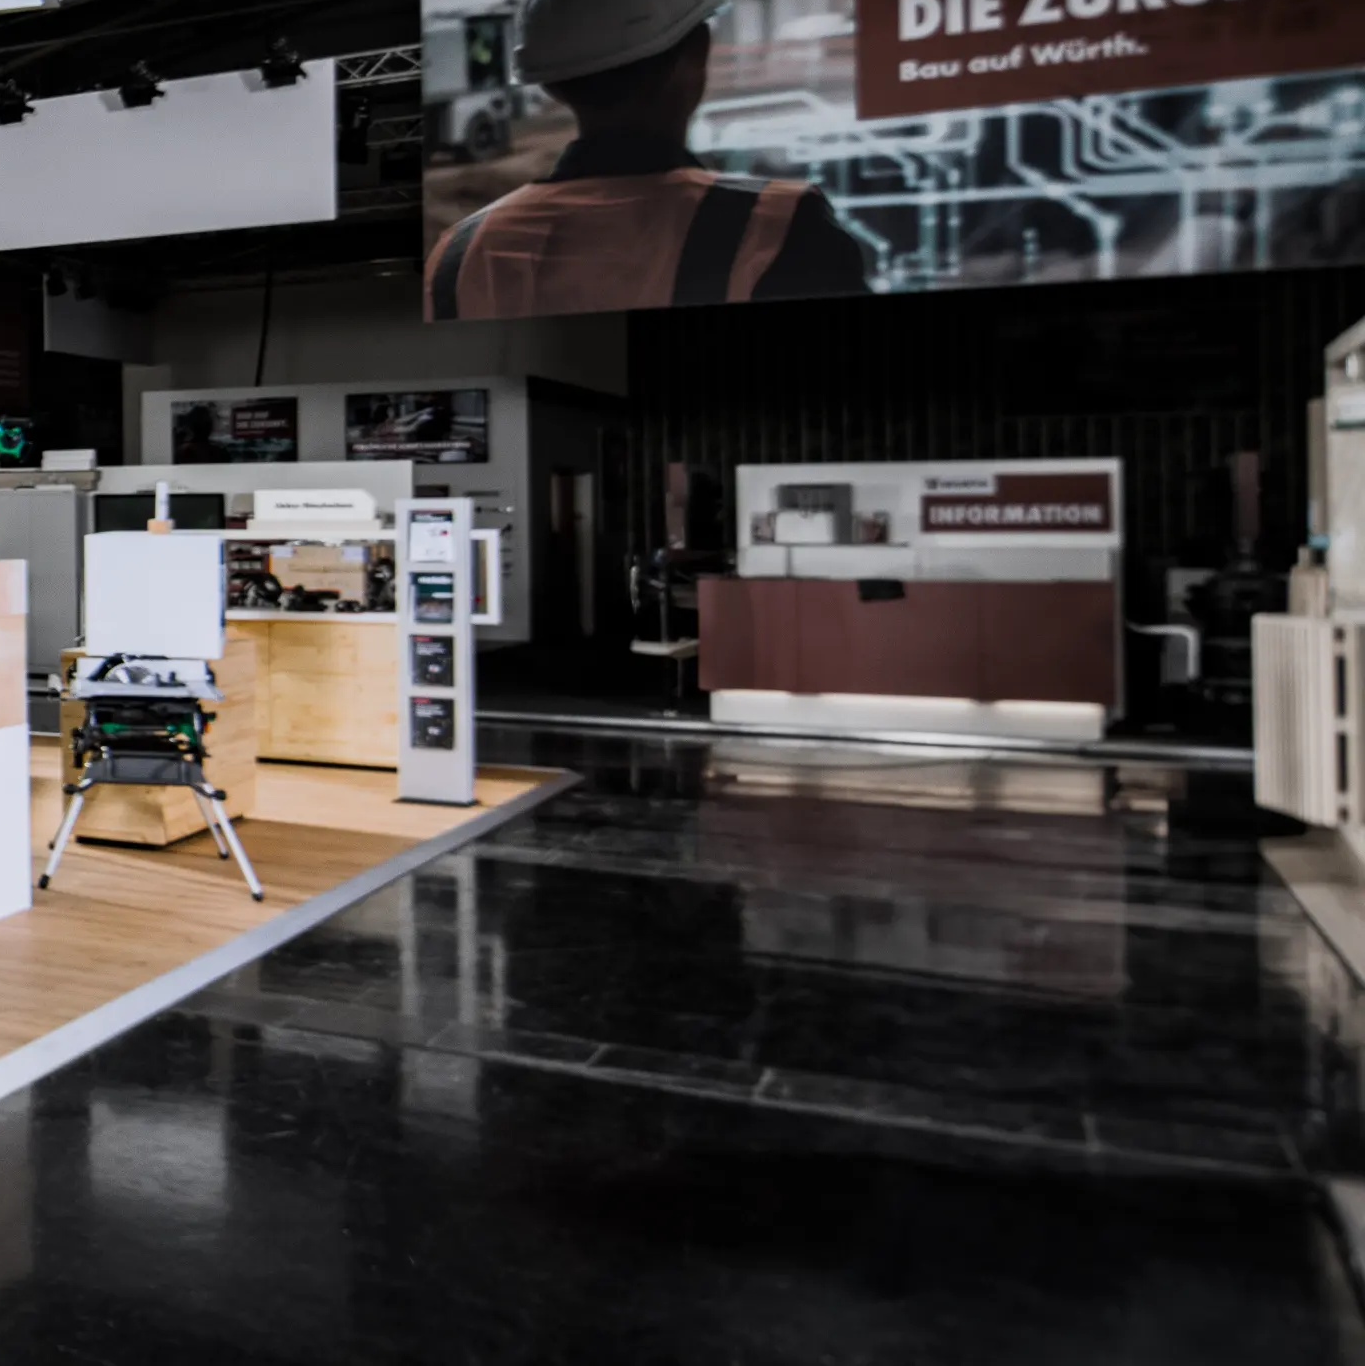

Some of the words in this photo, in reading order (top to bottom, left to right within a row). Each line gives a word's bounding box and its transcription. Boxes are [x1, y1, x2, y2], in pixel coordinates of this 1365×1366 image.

[898, 60, 960, 82] Bau
[968, 46, 1023, 73] auf
[929, 504, 1103, 524] INFORMATION
